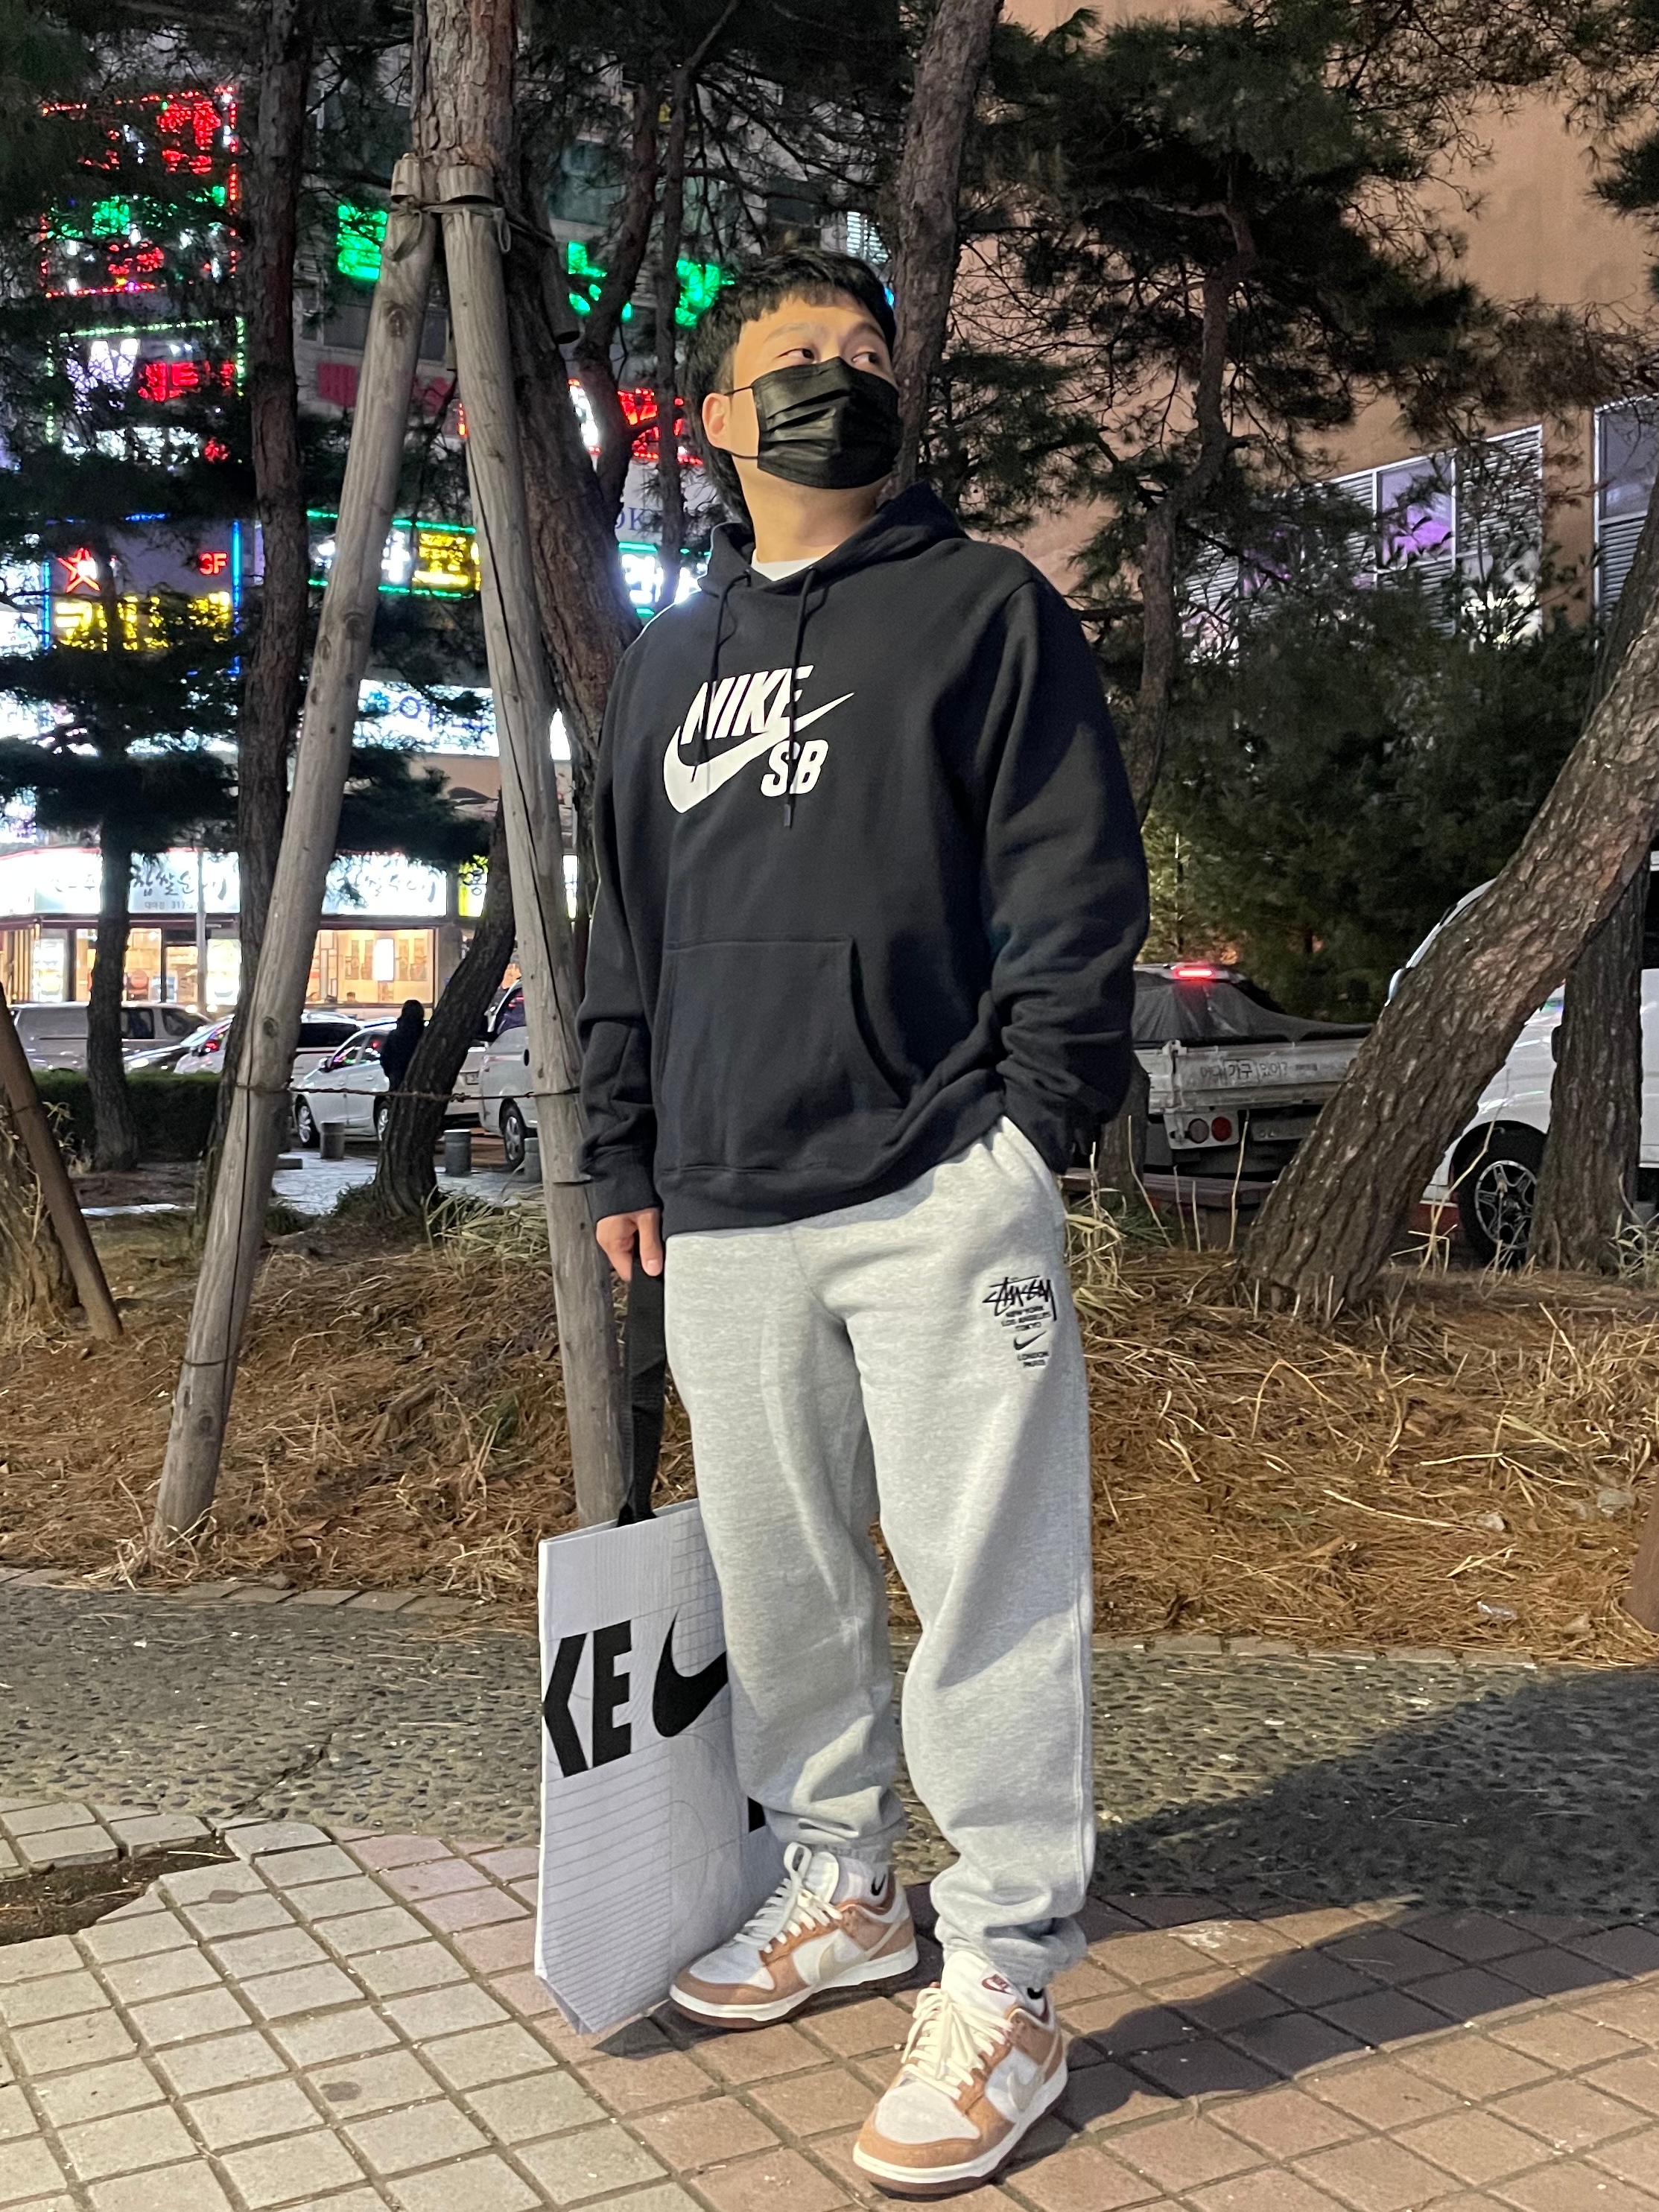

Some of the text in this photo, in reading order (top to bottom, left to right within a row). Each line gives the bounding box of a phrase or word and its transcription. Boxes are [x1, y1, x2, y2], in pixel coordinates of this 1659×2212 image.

[199, 552, 228, 576] 3F
[679, 664, 814, 746] NIKE
[760, 739, 830, 798] SB
